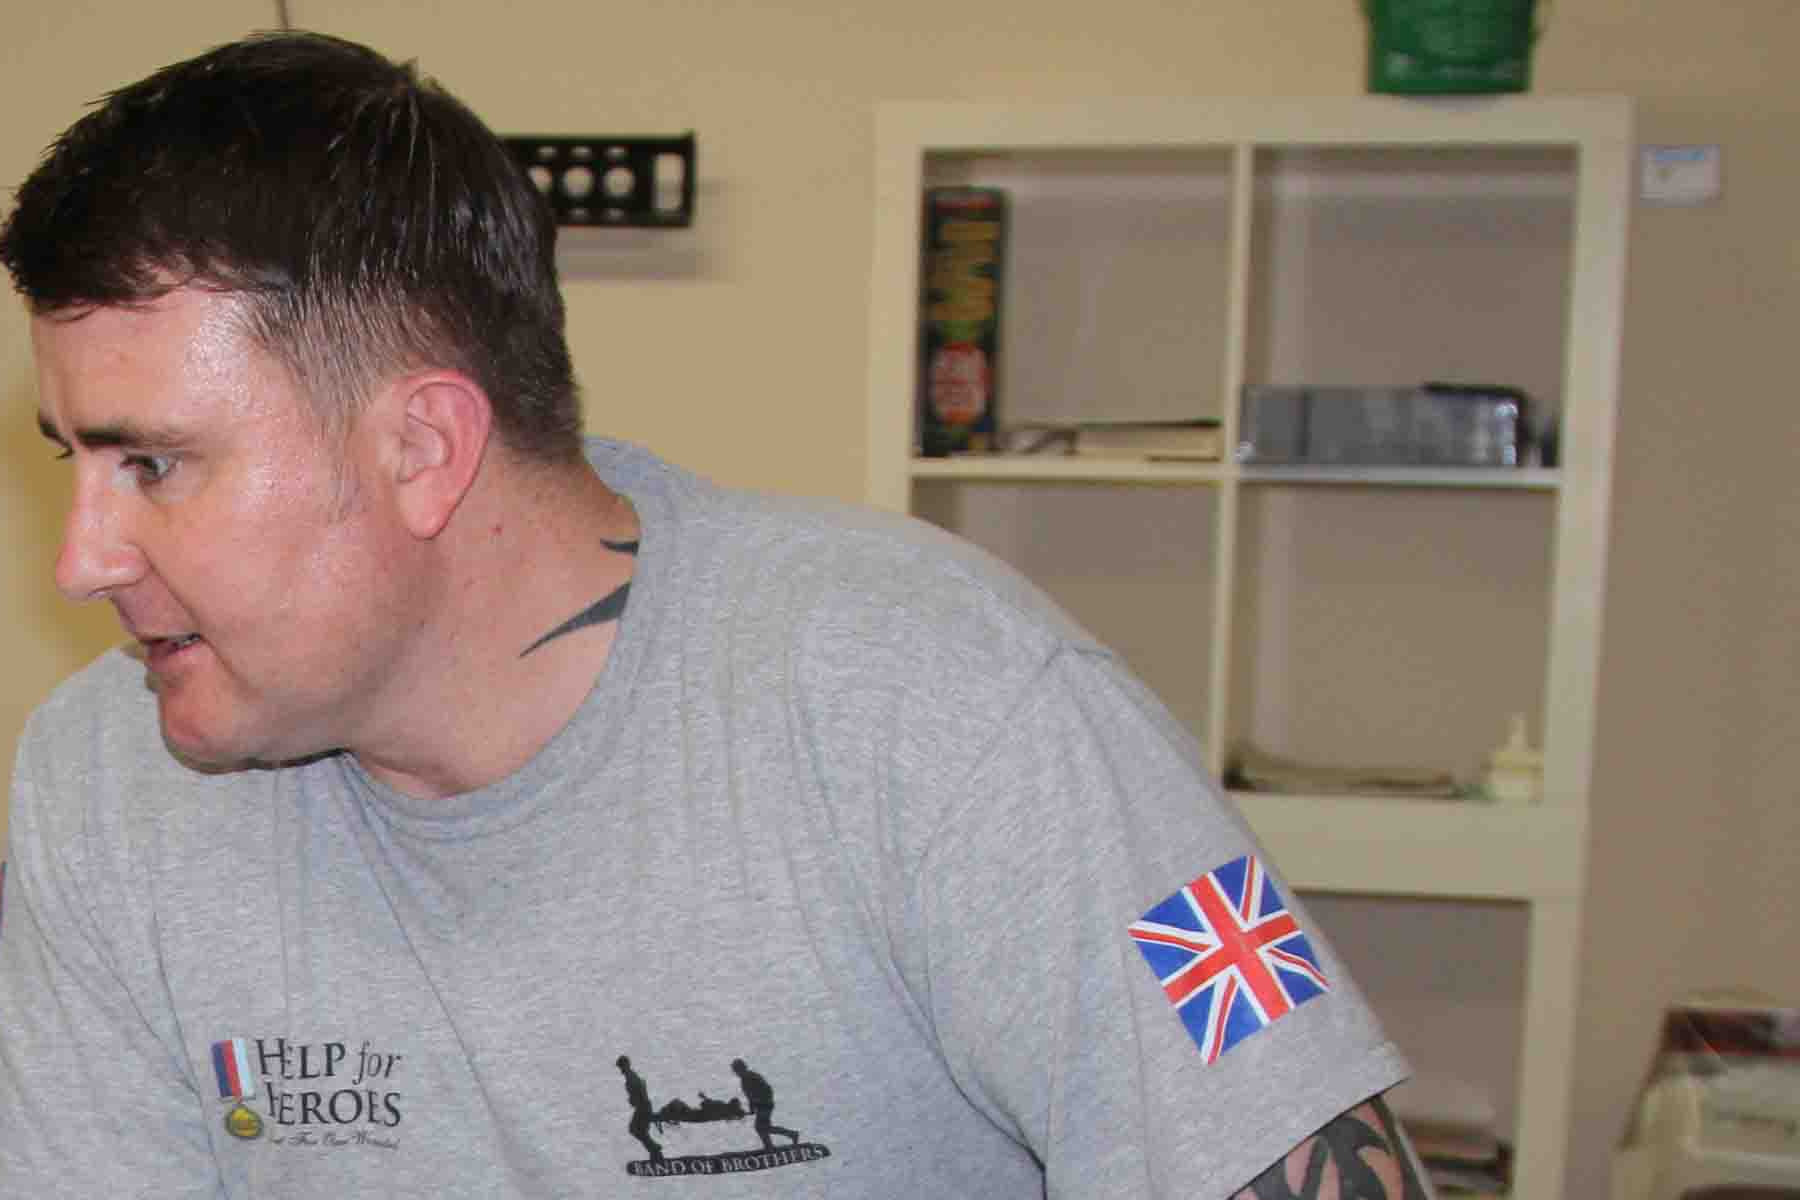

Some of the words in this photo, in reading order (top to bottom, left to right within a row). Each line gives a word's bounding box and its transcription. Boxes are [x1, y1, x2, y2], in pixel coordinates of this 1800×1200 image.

[256, 1038, 346, 1079] HELP
[352, 1040, 402, 1085] for
[264, 1081, 401, 1127] HEROES
[633, 1159, 687, 1177] BAND
[691, 1158, 714, 1174] OF
[721, 1144, 826, 1173] BROTHERS
